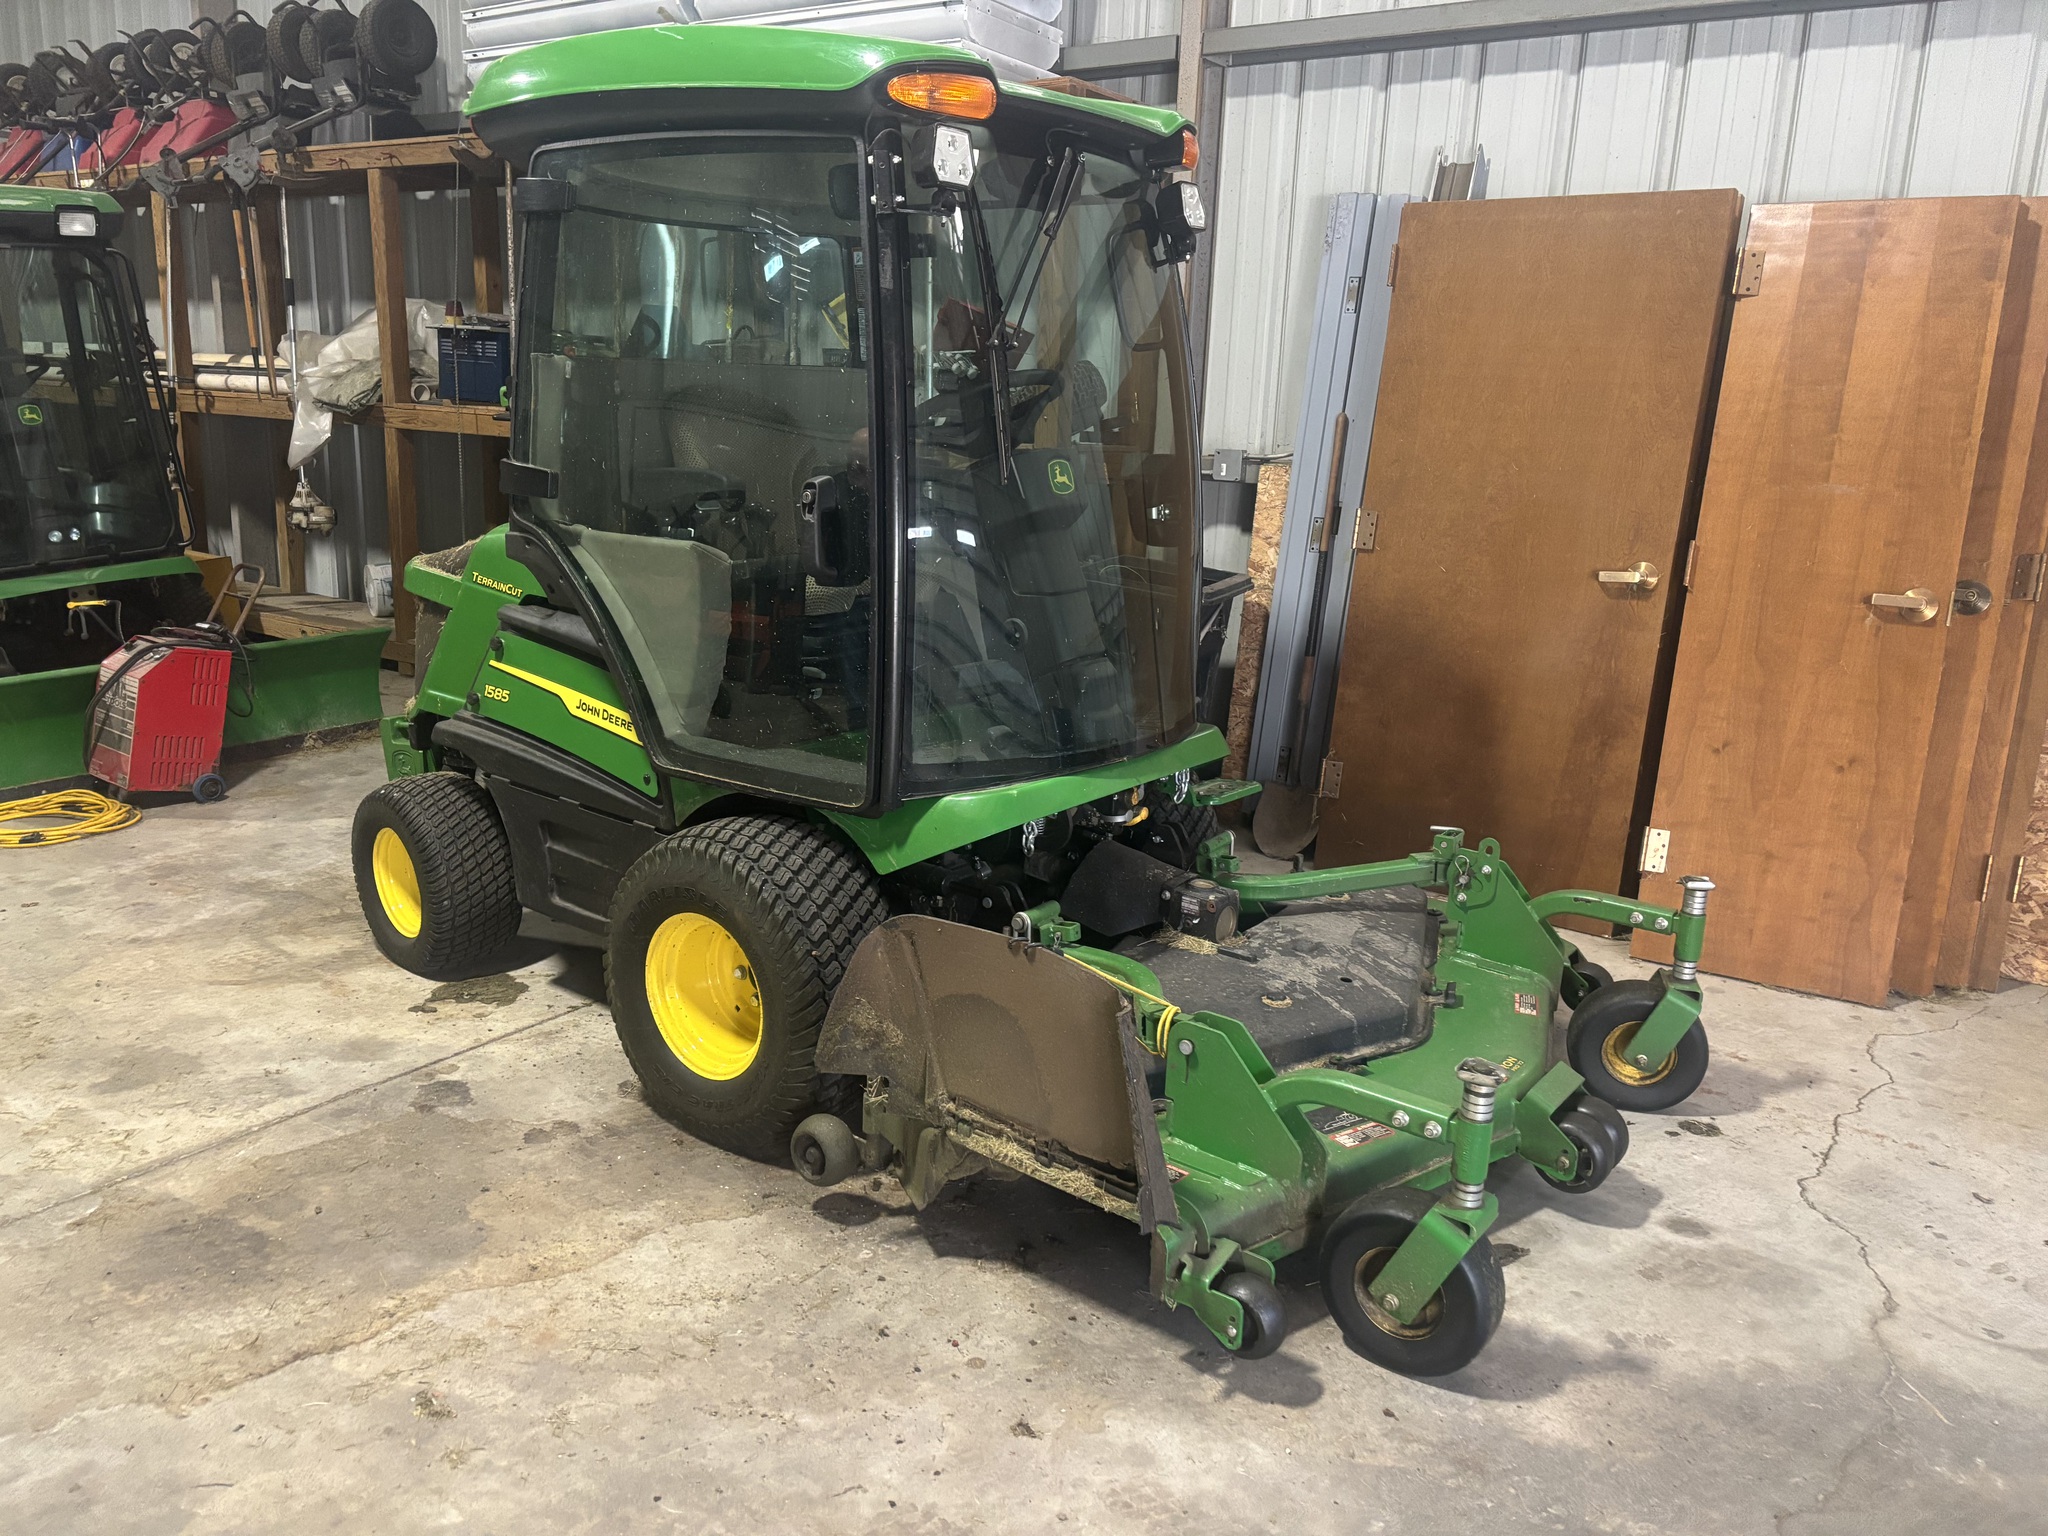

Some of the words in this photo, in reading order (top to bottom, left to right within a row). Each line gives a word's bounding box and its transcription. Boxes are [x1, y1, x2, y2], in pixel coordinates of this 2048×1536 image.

[484, 684, 510, 702] 1585
[575, 698, 601, 718] JOHN
[601, 709, 633, 731] DEERE
